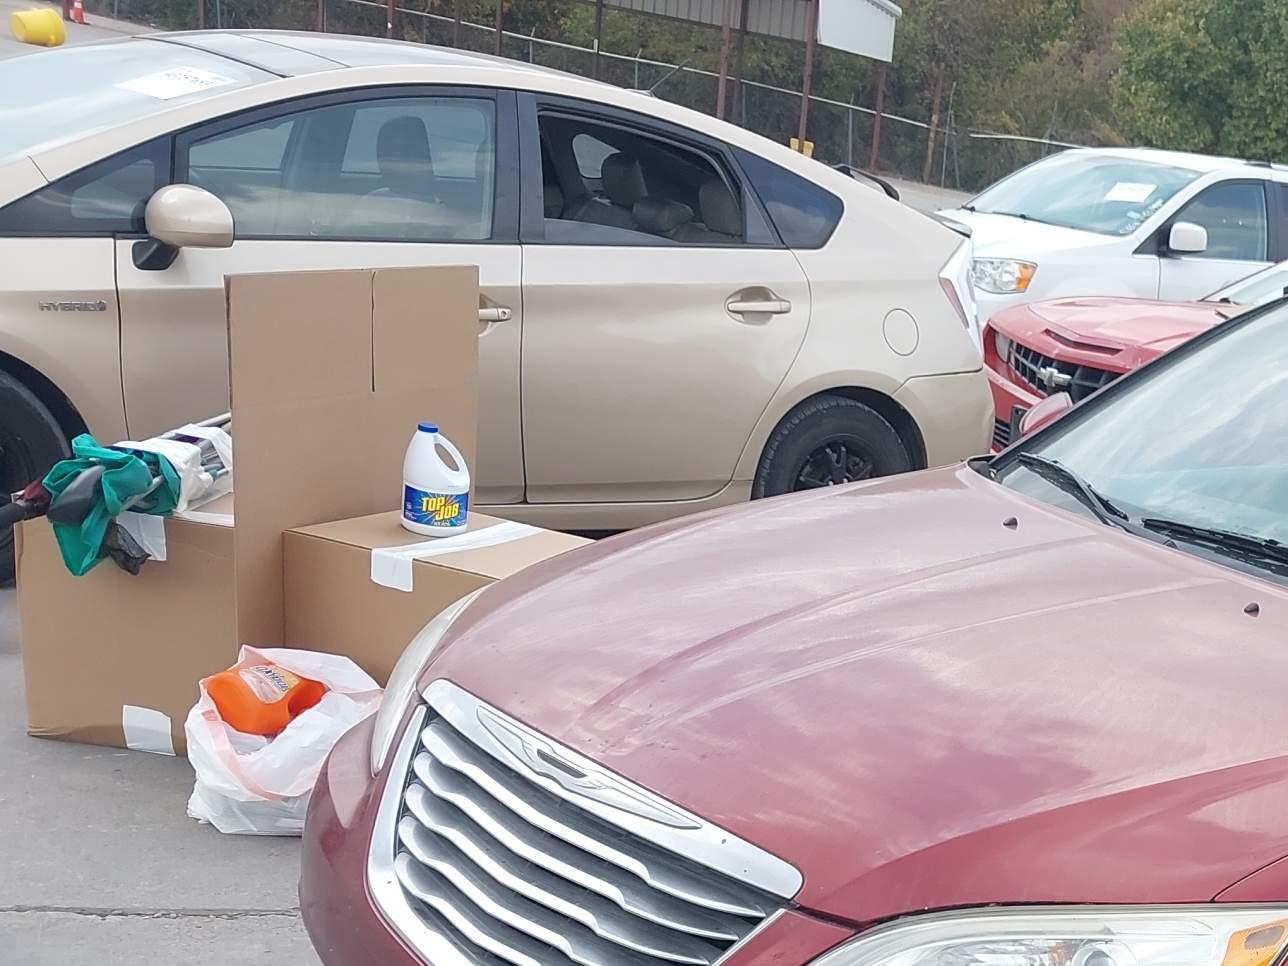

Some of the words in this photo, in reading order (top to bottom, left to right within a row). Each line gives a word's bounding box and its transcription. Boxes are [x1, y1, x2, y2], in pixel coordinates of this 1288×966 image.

[39, 301, 98, 312] HYBRID
[421, 496, 446, 512] TOP
[435, 503, 460, 521] JOB
